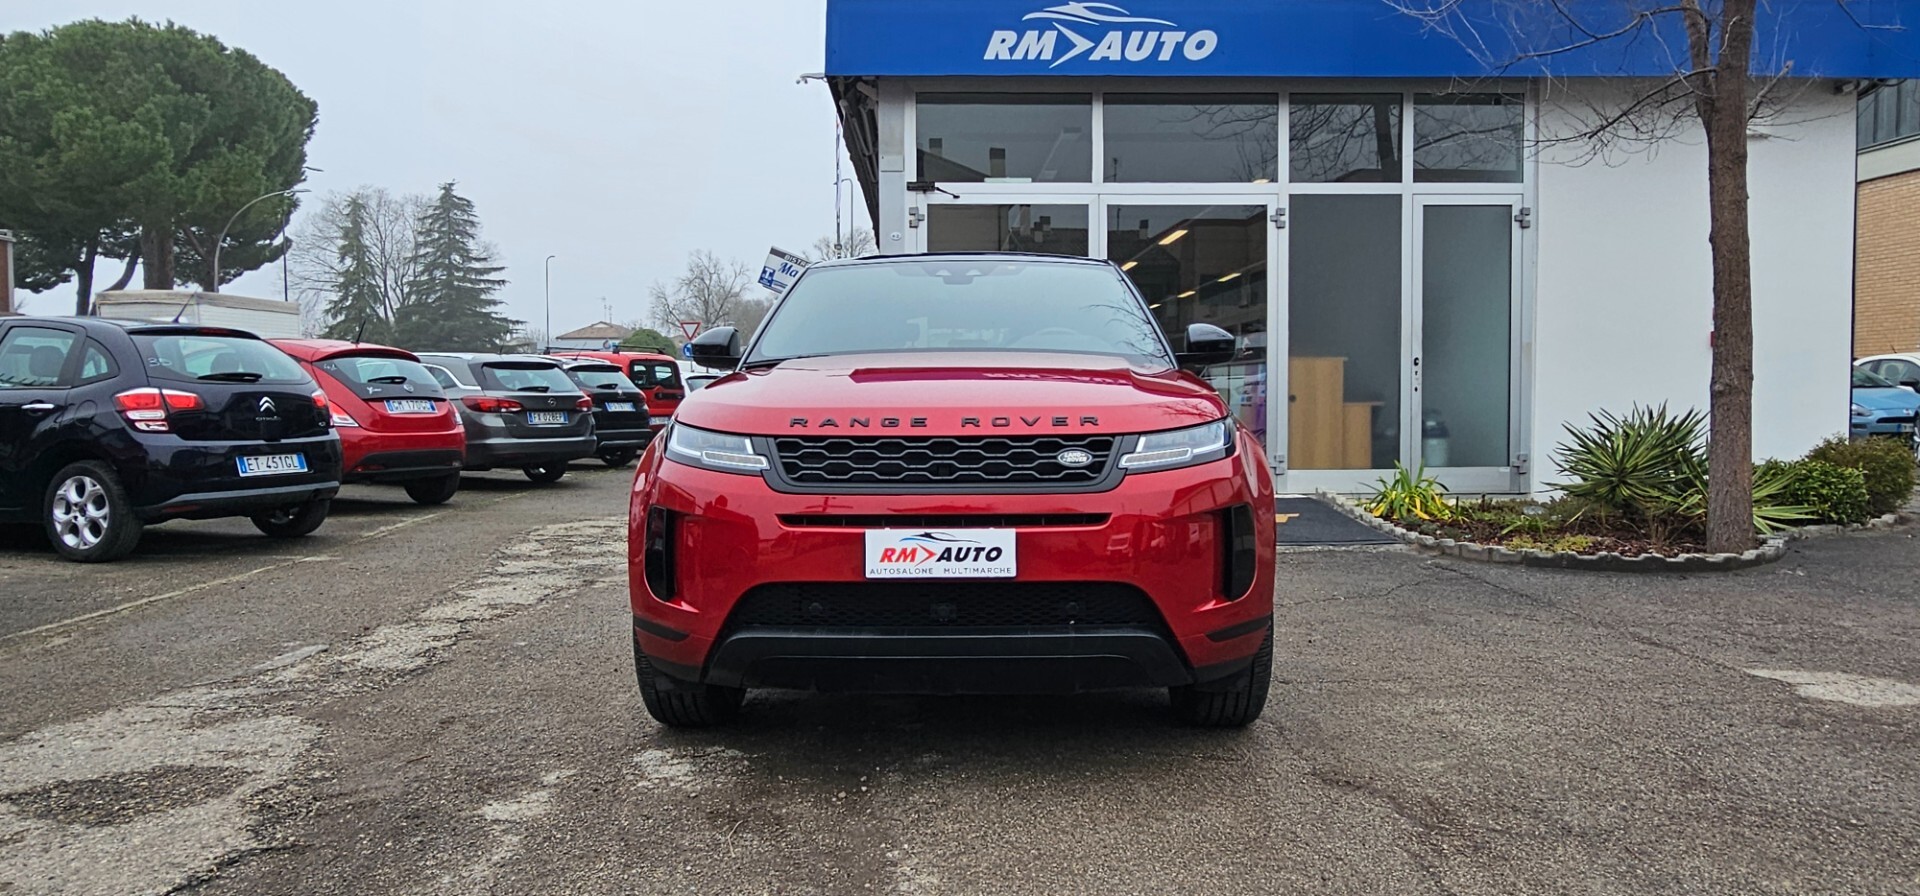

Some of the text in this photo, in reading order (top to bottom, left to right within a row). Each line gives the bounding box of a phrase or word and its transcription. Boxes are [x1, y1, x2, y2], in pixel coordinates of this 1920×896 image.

[1088, 30, 1218, 61] AUTO
[790, 416, 1099, 427] RANGE ROVER
[935, 547, 1003, 563] AUTO
[943, 567, 1012, 575] MULTIMARCHE
